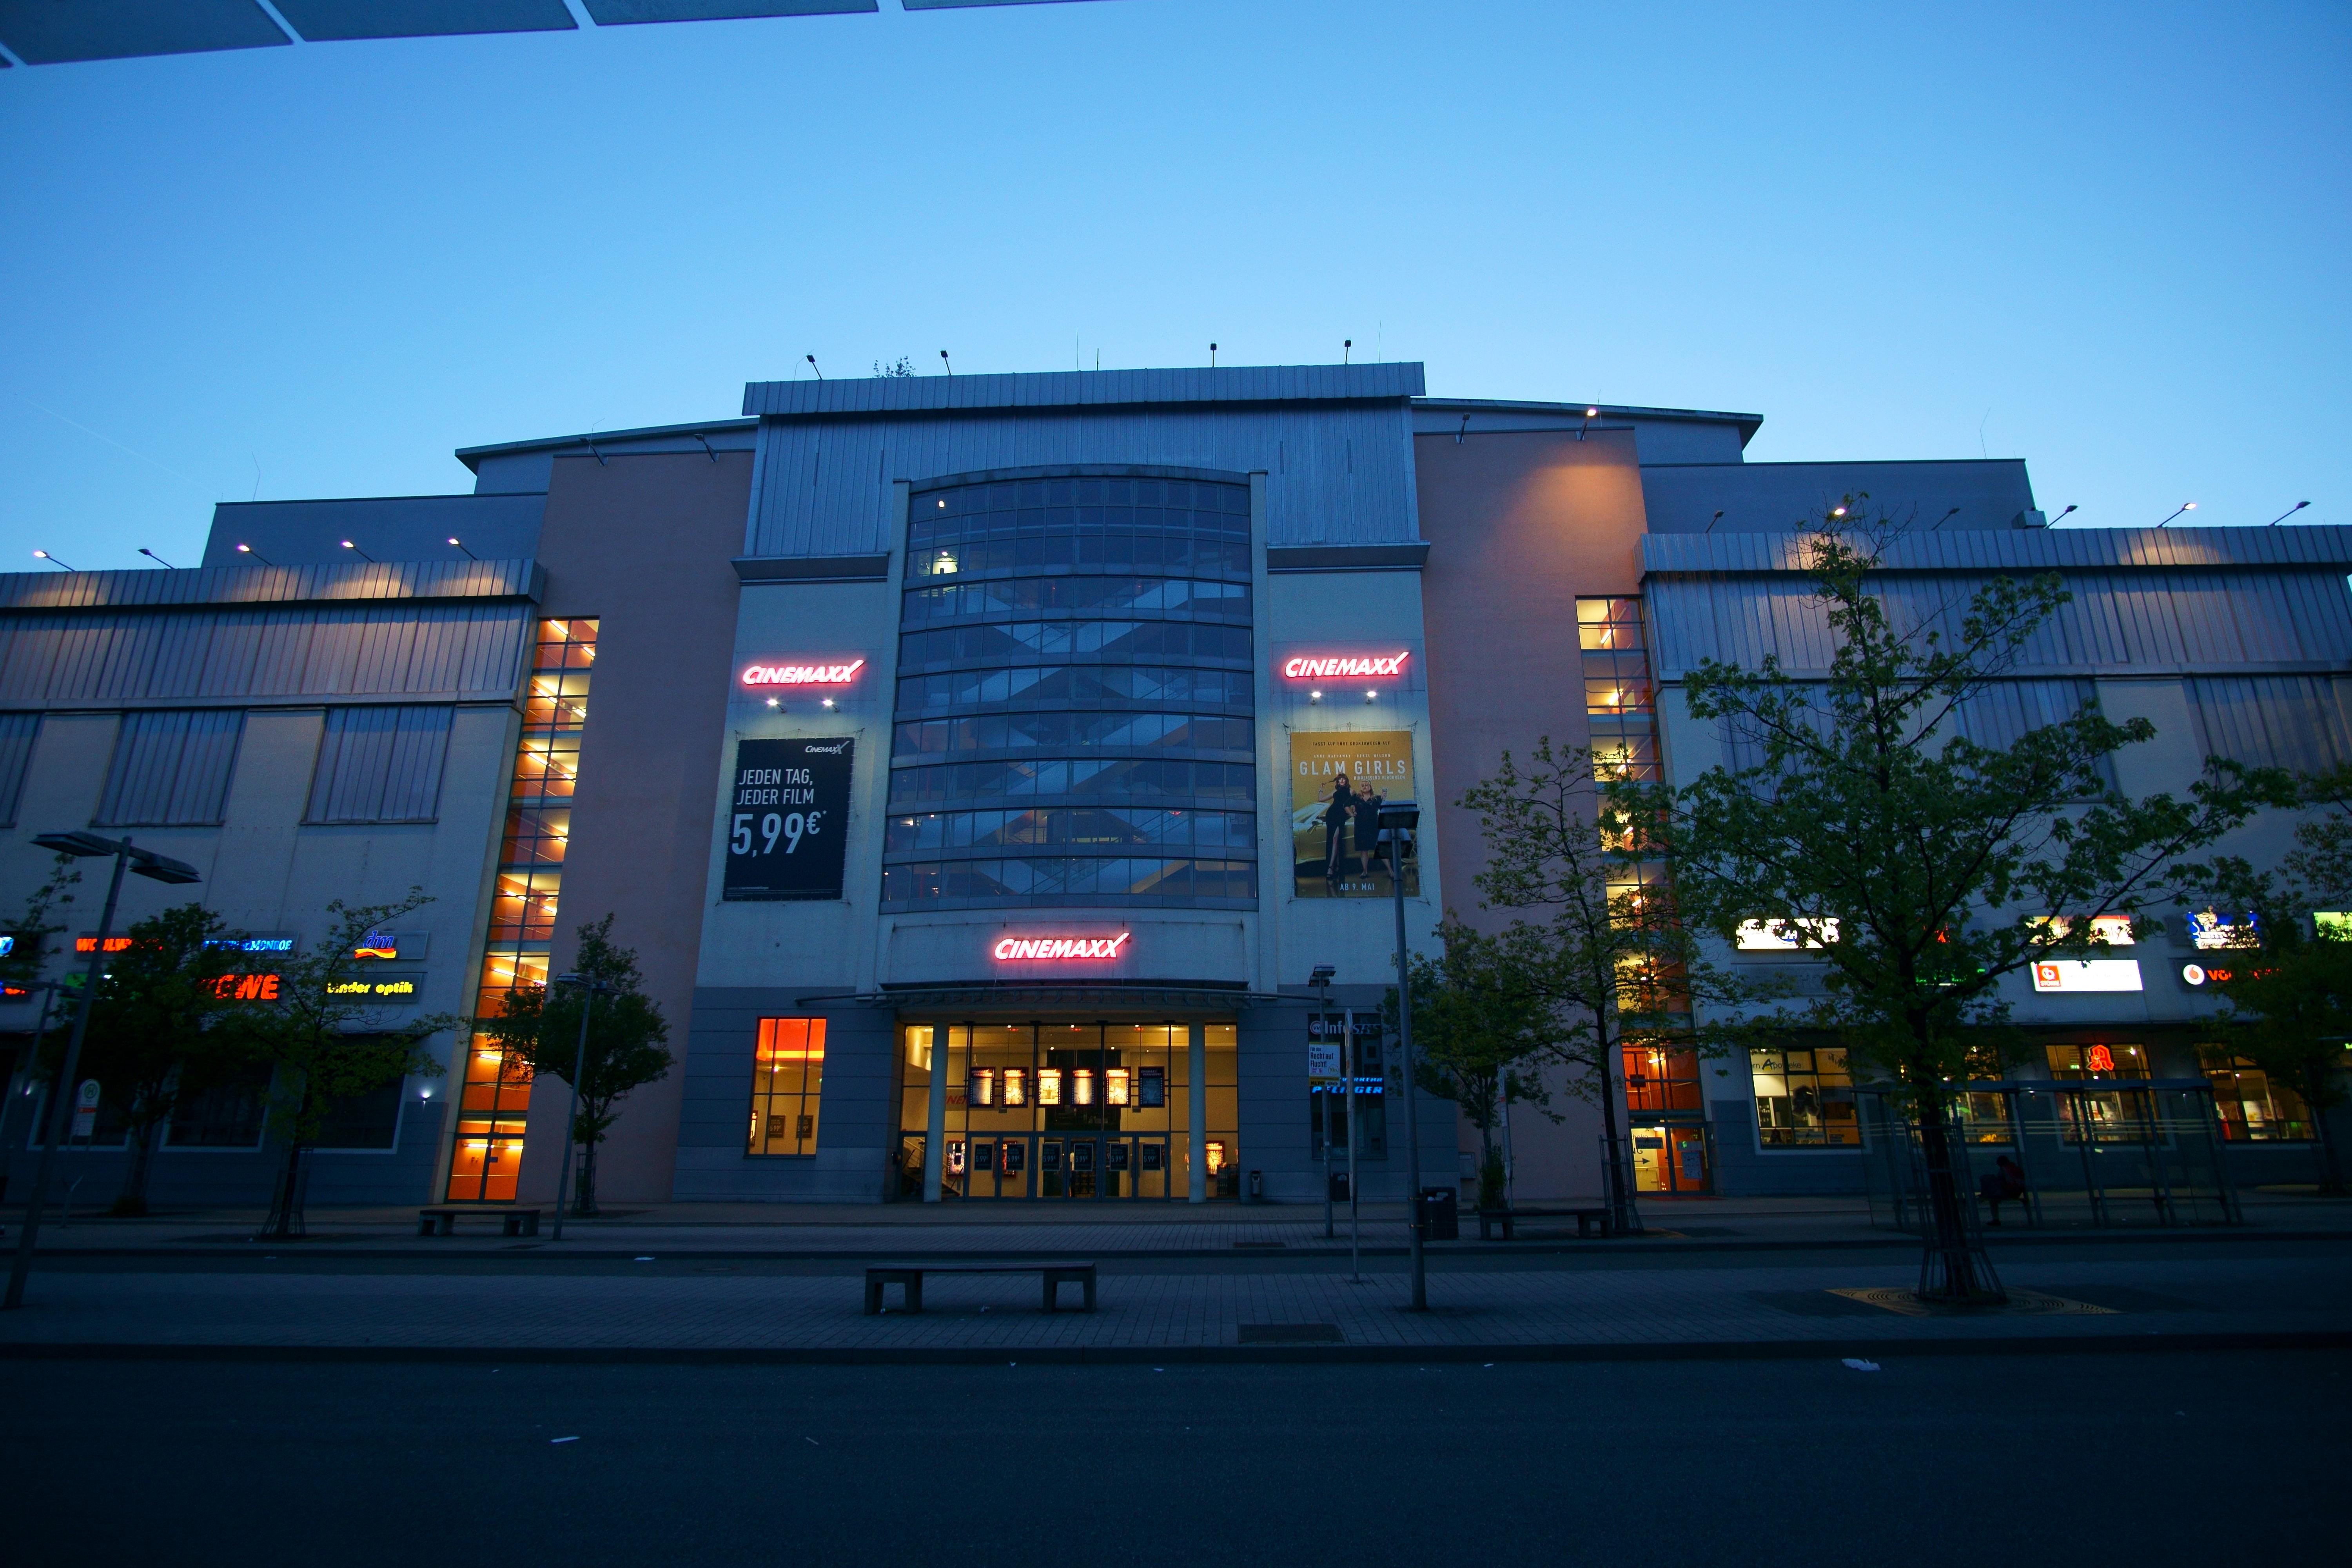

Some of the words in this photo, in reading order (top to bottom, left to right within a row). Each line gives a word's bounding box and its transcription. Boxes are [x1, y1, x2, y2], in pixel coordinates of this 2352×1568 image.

[743, 660, 864, 685] CINEMAXX
[1285, 652, 1409, 677] CINEMAXX
[805, 740, 850, 754] CINEMAXX
[1300, 760, 1345, 775] GLAM
[1355, 760, 1405, 775] GIRLS
[739, 769, 781, 785] JEDEN
[786, 768, 813, 786] TAG,
[736, 789, 779, 805] JEDER
[784, 788, 814, 804] FILM
[1361, 883, 1374, 891] MAI
[363, 930, 394, 948] dm
[995, 933, 1129, 959] CINEMAXX
[376, 981, 413, 996] optik
[1325, 1020, 1346, 1034] Inf
